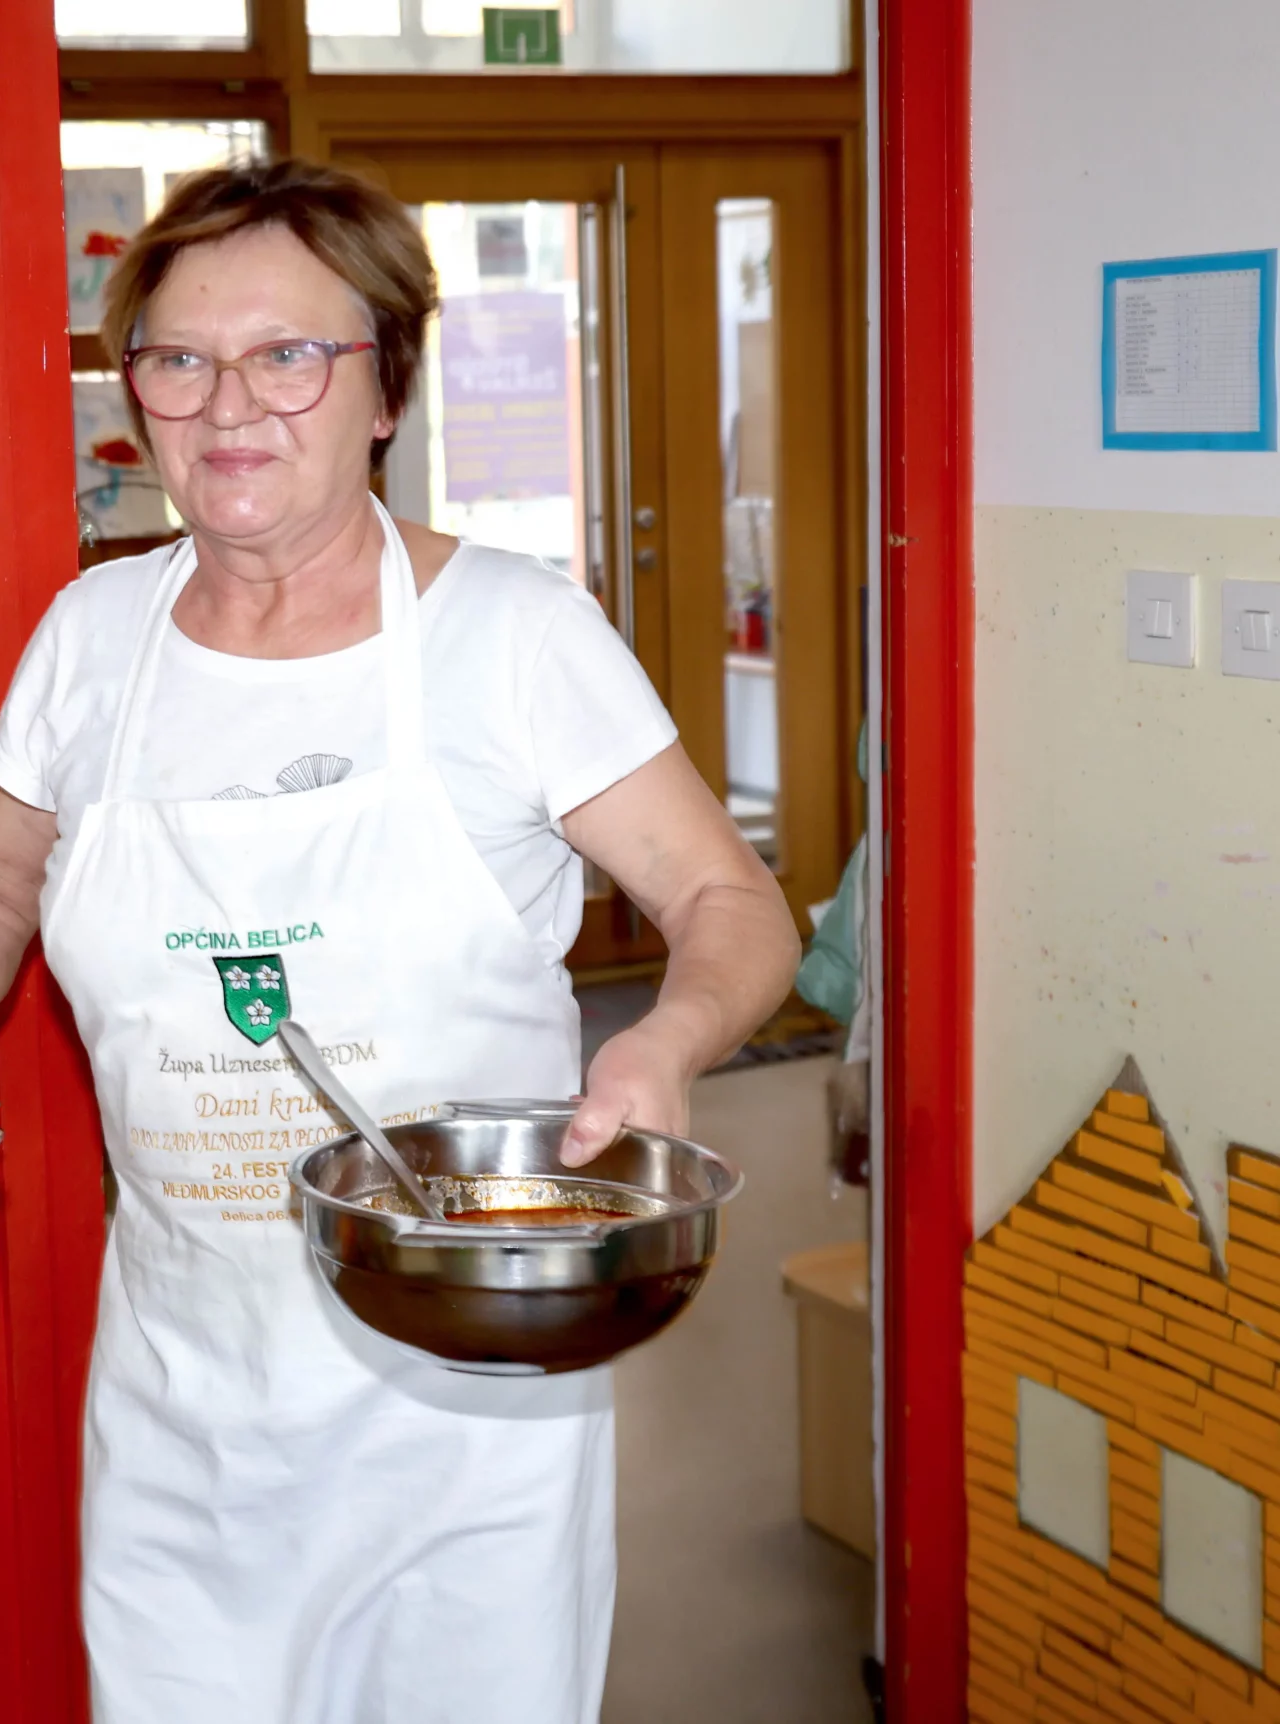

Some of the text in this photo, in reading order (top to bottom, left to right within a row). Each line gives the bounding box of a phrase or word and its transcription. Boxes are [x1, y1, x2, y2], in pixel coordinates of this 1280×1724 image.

[247, 922, 325, 949] BELICA
[159, 1048, 206, 1081] Župa
[195, 1090, 260, 1118] Dani
[269, 1130, 291, 1151] ZA
[212, 1161, 289, 1179] 24. FEST
[221, 1210, 263, 1222] Belica
